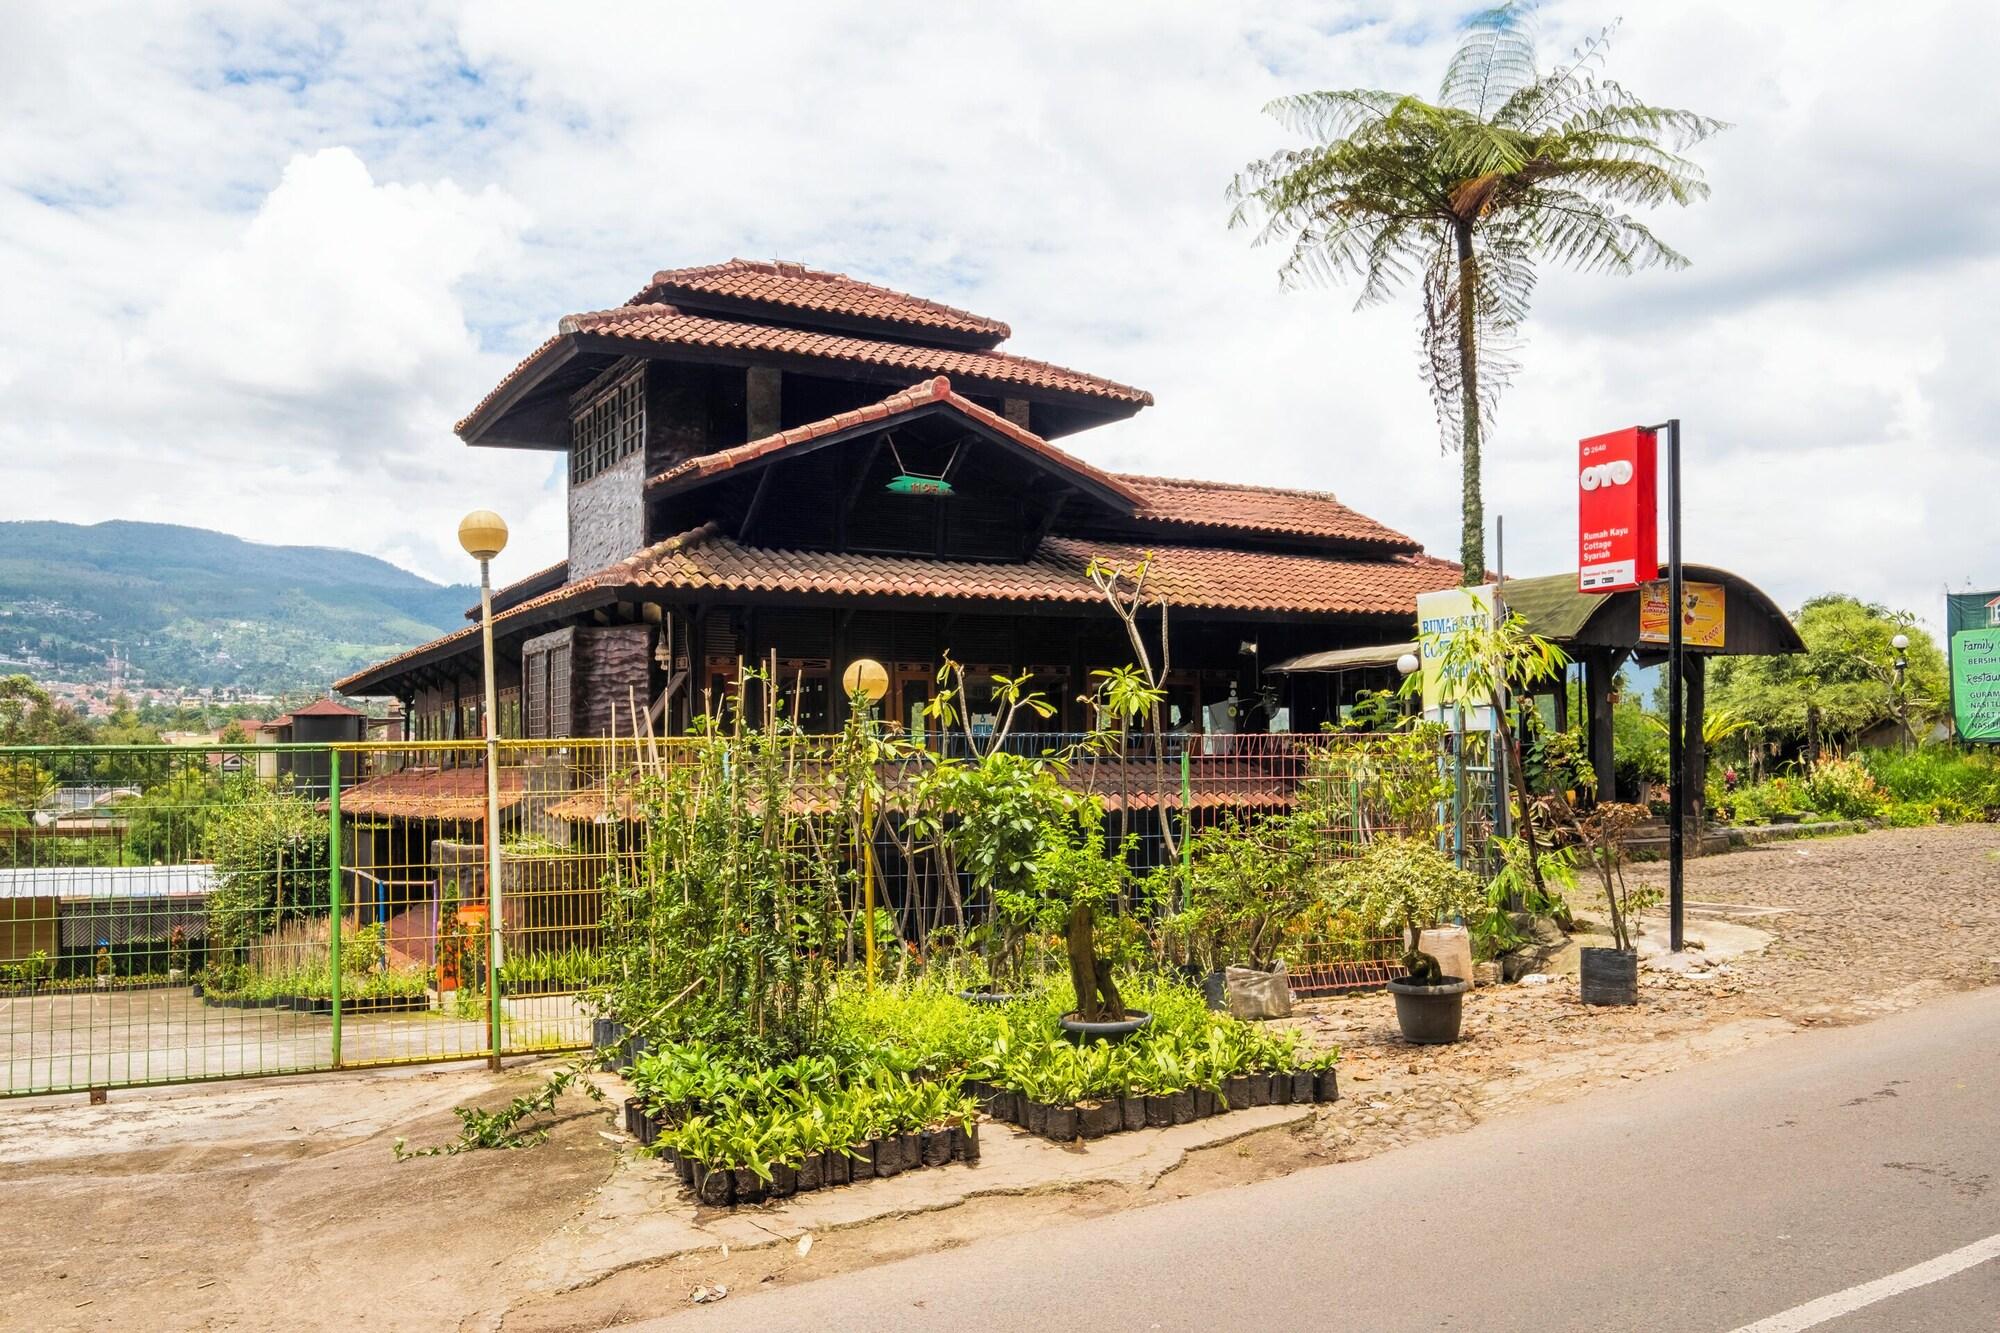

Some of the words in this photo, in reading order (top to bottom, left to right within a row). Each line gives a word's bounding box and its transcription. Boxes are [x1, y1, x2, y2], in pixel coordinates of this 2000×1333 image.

[1580, 460, 1633, 491] OYO
[1583, 529, 1608, 540] Rumah
[1610, 527, 1629, 537] Kayu
[1583, 541, 1612, 551] Cottage
[1583, 550, 1611, 562] Syariah
[1963, 638, 1994, 654] Family
[1968, 657, 1997, 665] BERSIH
[1970, 711, 1995, 719] PAKET
